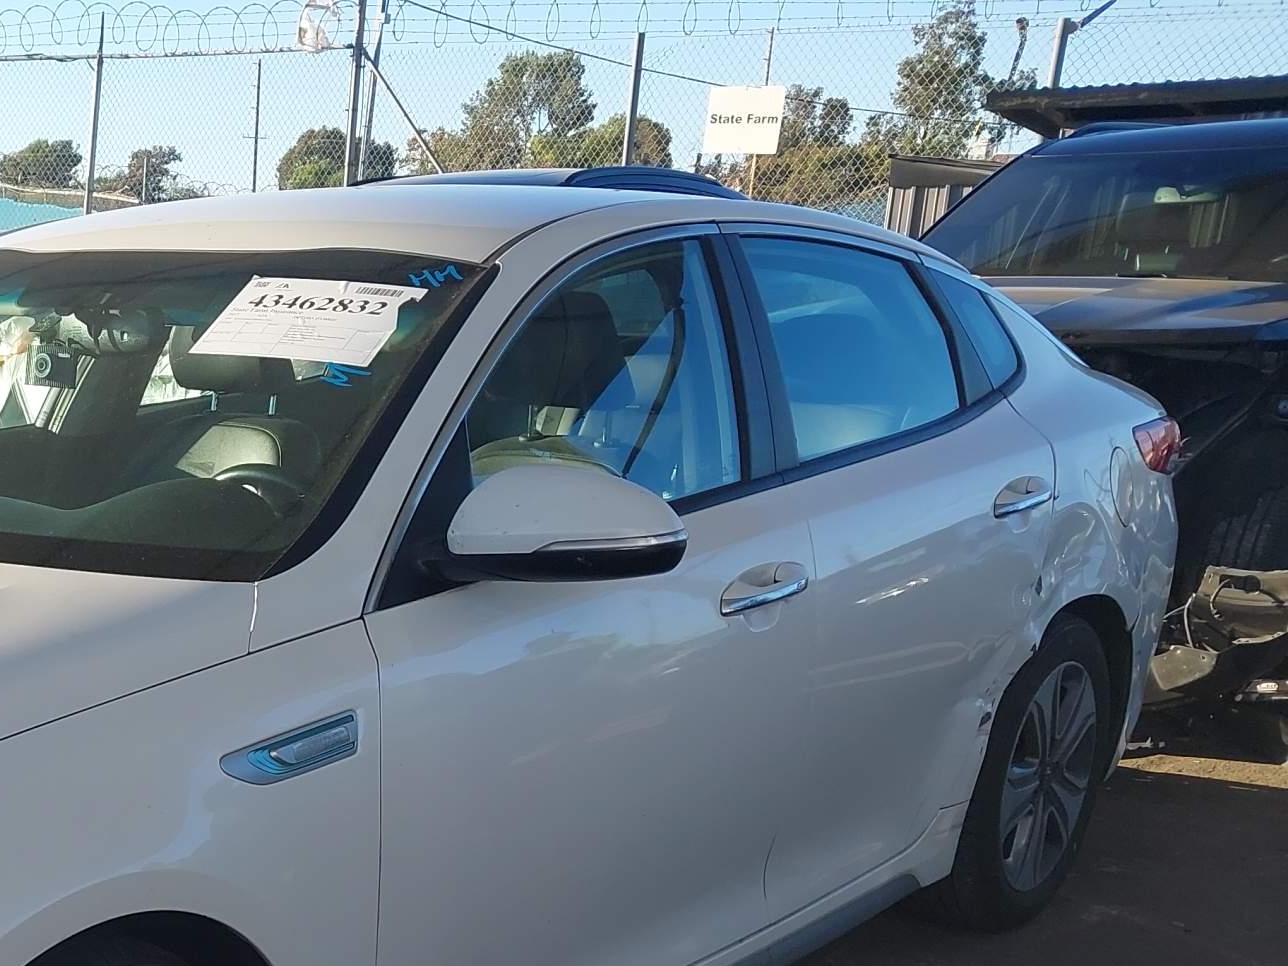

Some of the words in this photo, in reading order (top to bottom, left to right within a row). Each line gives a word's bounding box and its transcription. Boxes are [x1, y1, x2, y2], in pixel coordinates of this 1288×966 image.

[710, 113, 743, 124] State
[746, 113, 779, 124] Farm
[248, 293, 388, 316] 43462832
